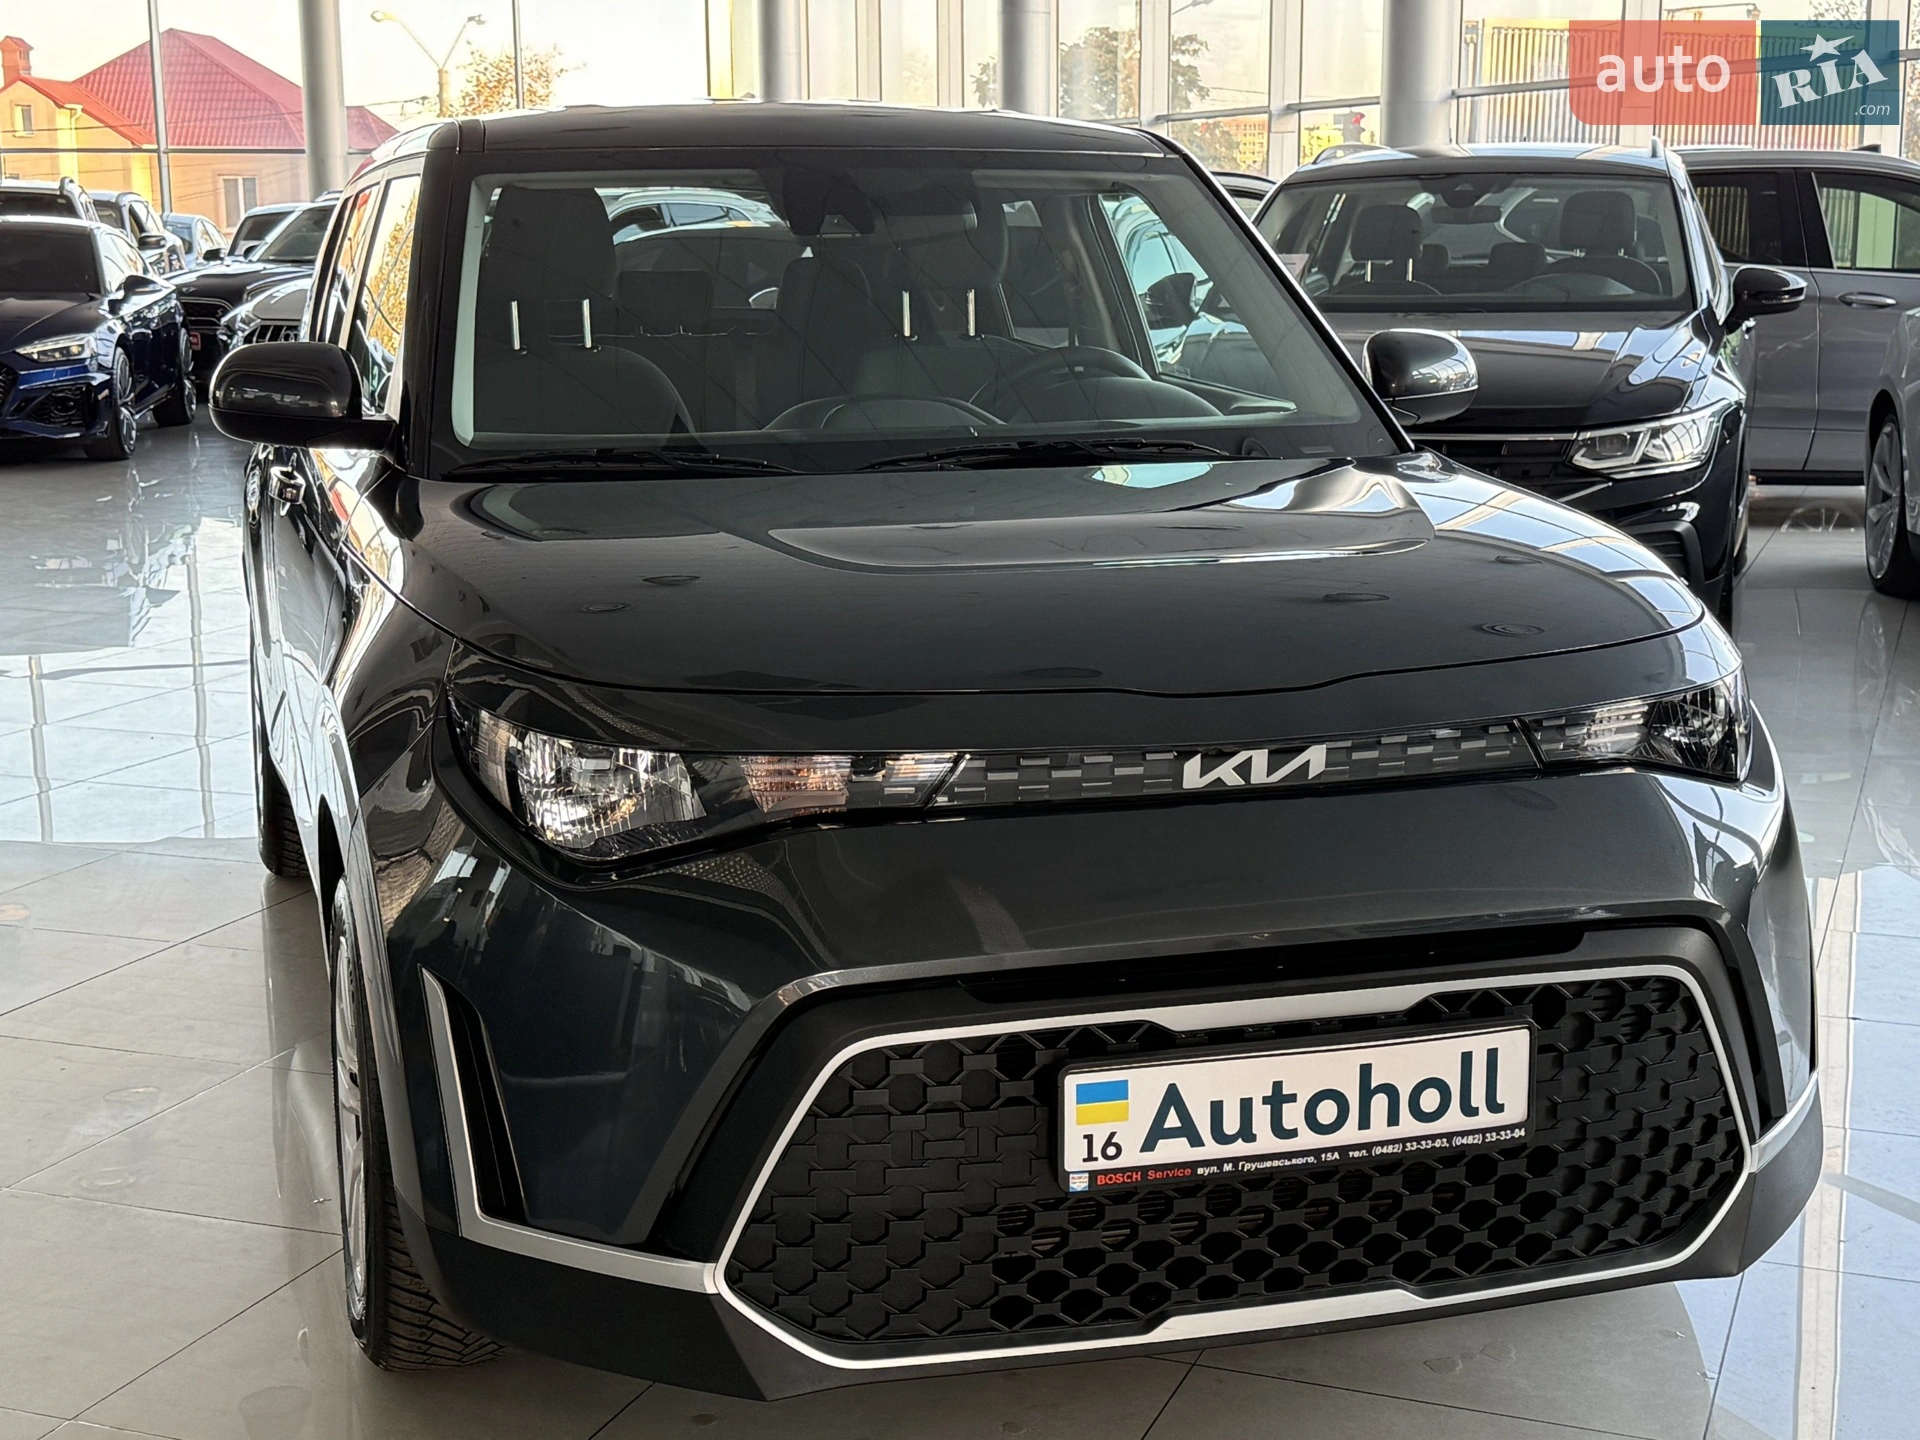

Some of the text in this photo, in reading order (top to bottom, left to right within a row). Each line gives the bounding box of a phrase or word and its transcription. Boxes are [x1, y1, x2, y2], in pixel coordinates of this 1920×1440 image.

[1183, 744, 1327, 789] KIA
[1139, 1047, 1505, 1153] Autoholl
[1082, 1131, 1123, 1163] 16
[1196, 1165, 1220, 1176] вул.
[1238, 1155, 1318, 1172] Грушевського,
[1371, 1142, 1402, 1157] (0482)
[1405, 1138, 1450, 1152] 33-33-03,
[1452, 1134, 1483, 1148] (0482)
[1485, 1127, 1526, 1143] 33-33-04
[1097, 1171, 1142, 1186] BOSCH
[1147, 1167, 1192, 1181] Service
